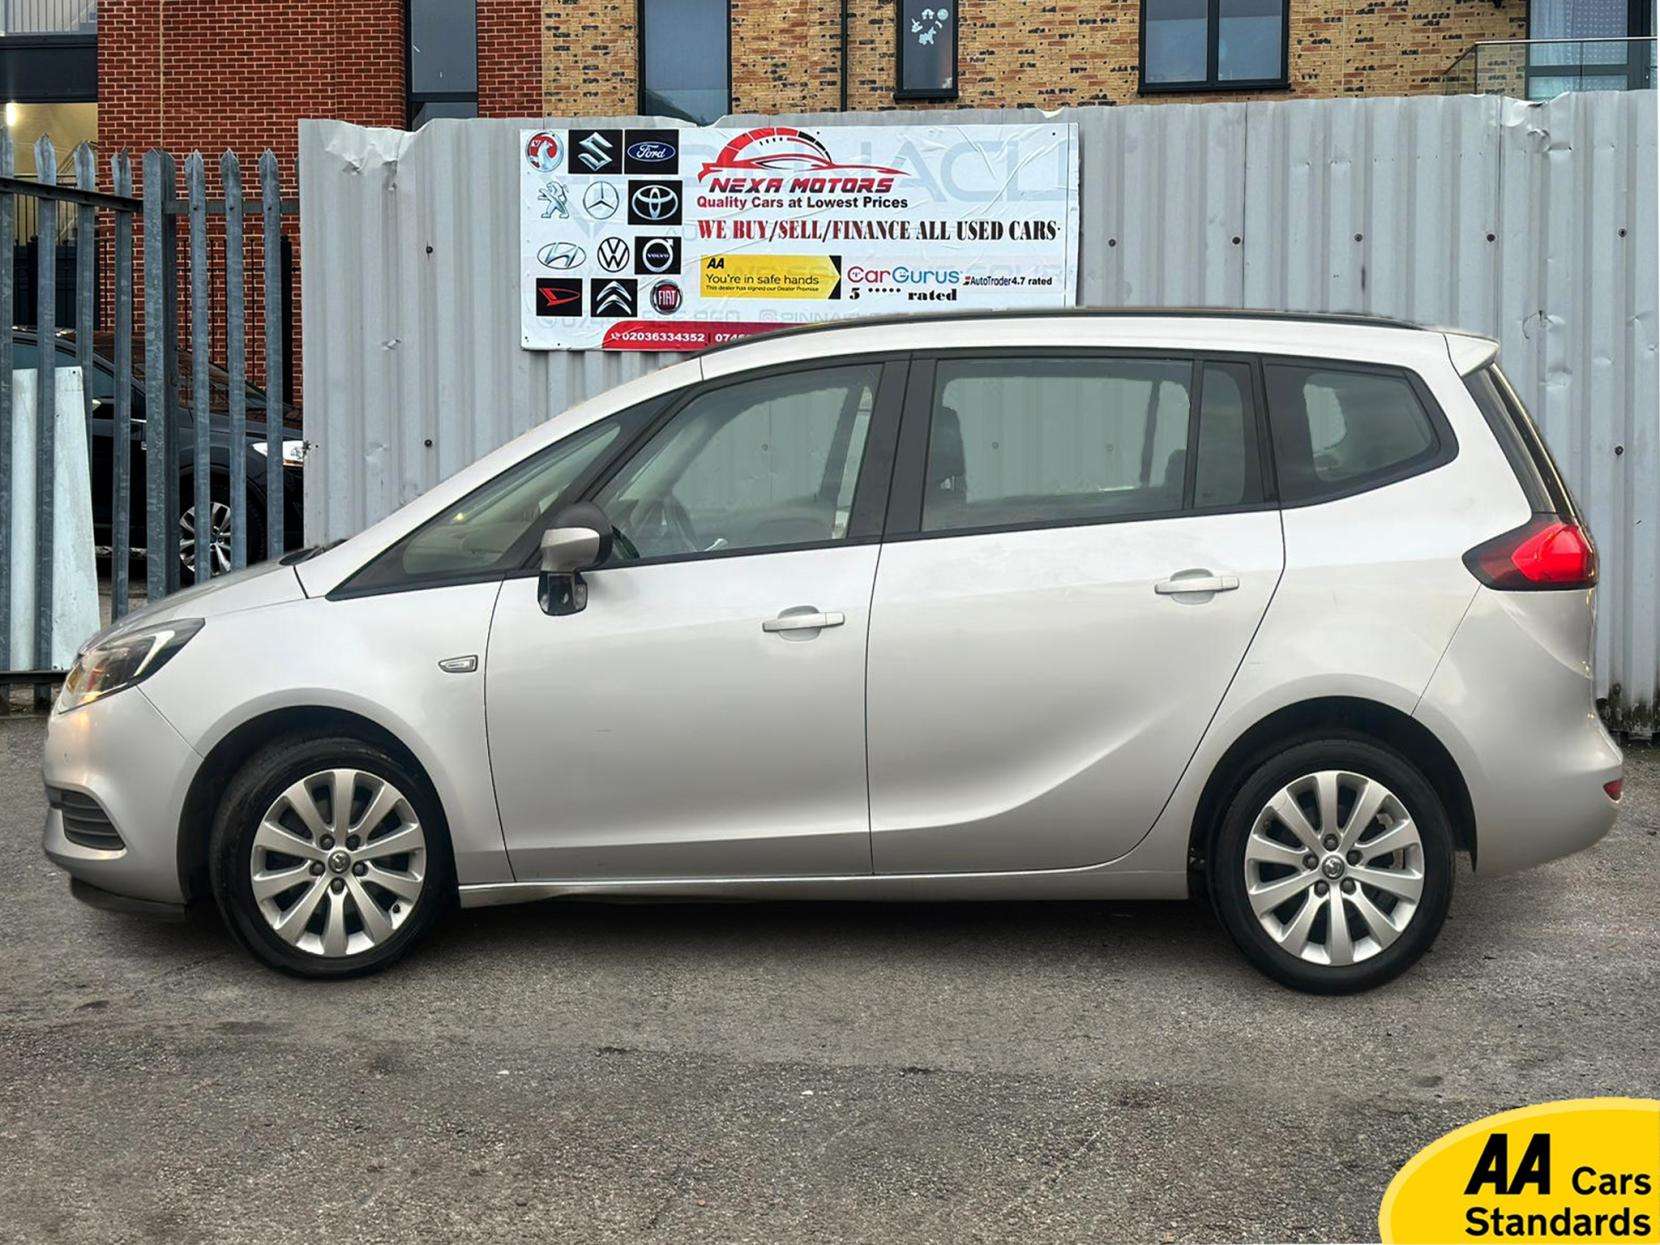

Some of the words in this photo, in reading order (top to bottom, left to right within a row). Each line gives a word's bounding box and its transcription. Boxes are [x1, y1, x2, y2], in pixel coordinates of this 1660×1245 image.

[636, 144, 666, 159] Ford
[709, 178, 784, 193] NEXA
[789, 178, 894, 193] MOTORS
[697, 196, 747, 210] Quality
[752, 196, 784, 208] Cars
[788, 197, 803, 208] at
[807, 196, 858, 208] Lowest
[863, 196, 908, 208] Prices
[697, 220, 727, 239] WE
[733, 220, 911, 242] BUY/SELL/FINANCE
[916, 221, 951, 240] ALL
[956, 221, 1004, 240] USED
[1008, 221, 1057, 240] CARS
[707, 257, 725, 269] AA
[706, 274, 741, 284] You're
[744, 274, 754, 284] in
[757, 274, 780, 284] safe
[783, 275, 819, 285] hands
[847, 265, 960, 284] CarGurus
[1028, 277, 1053, 285] rated
[658, 290, 676, 306] FIAT
[849, 287, 860, 300] 5
[908, 288, 957, 301] rated
[622, 332, 705, 342] 02036334352
